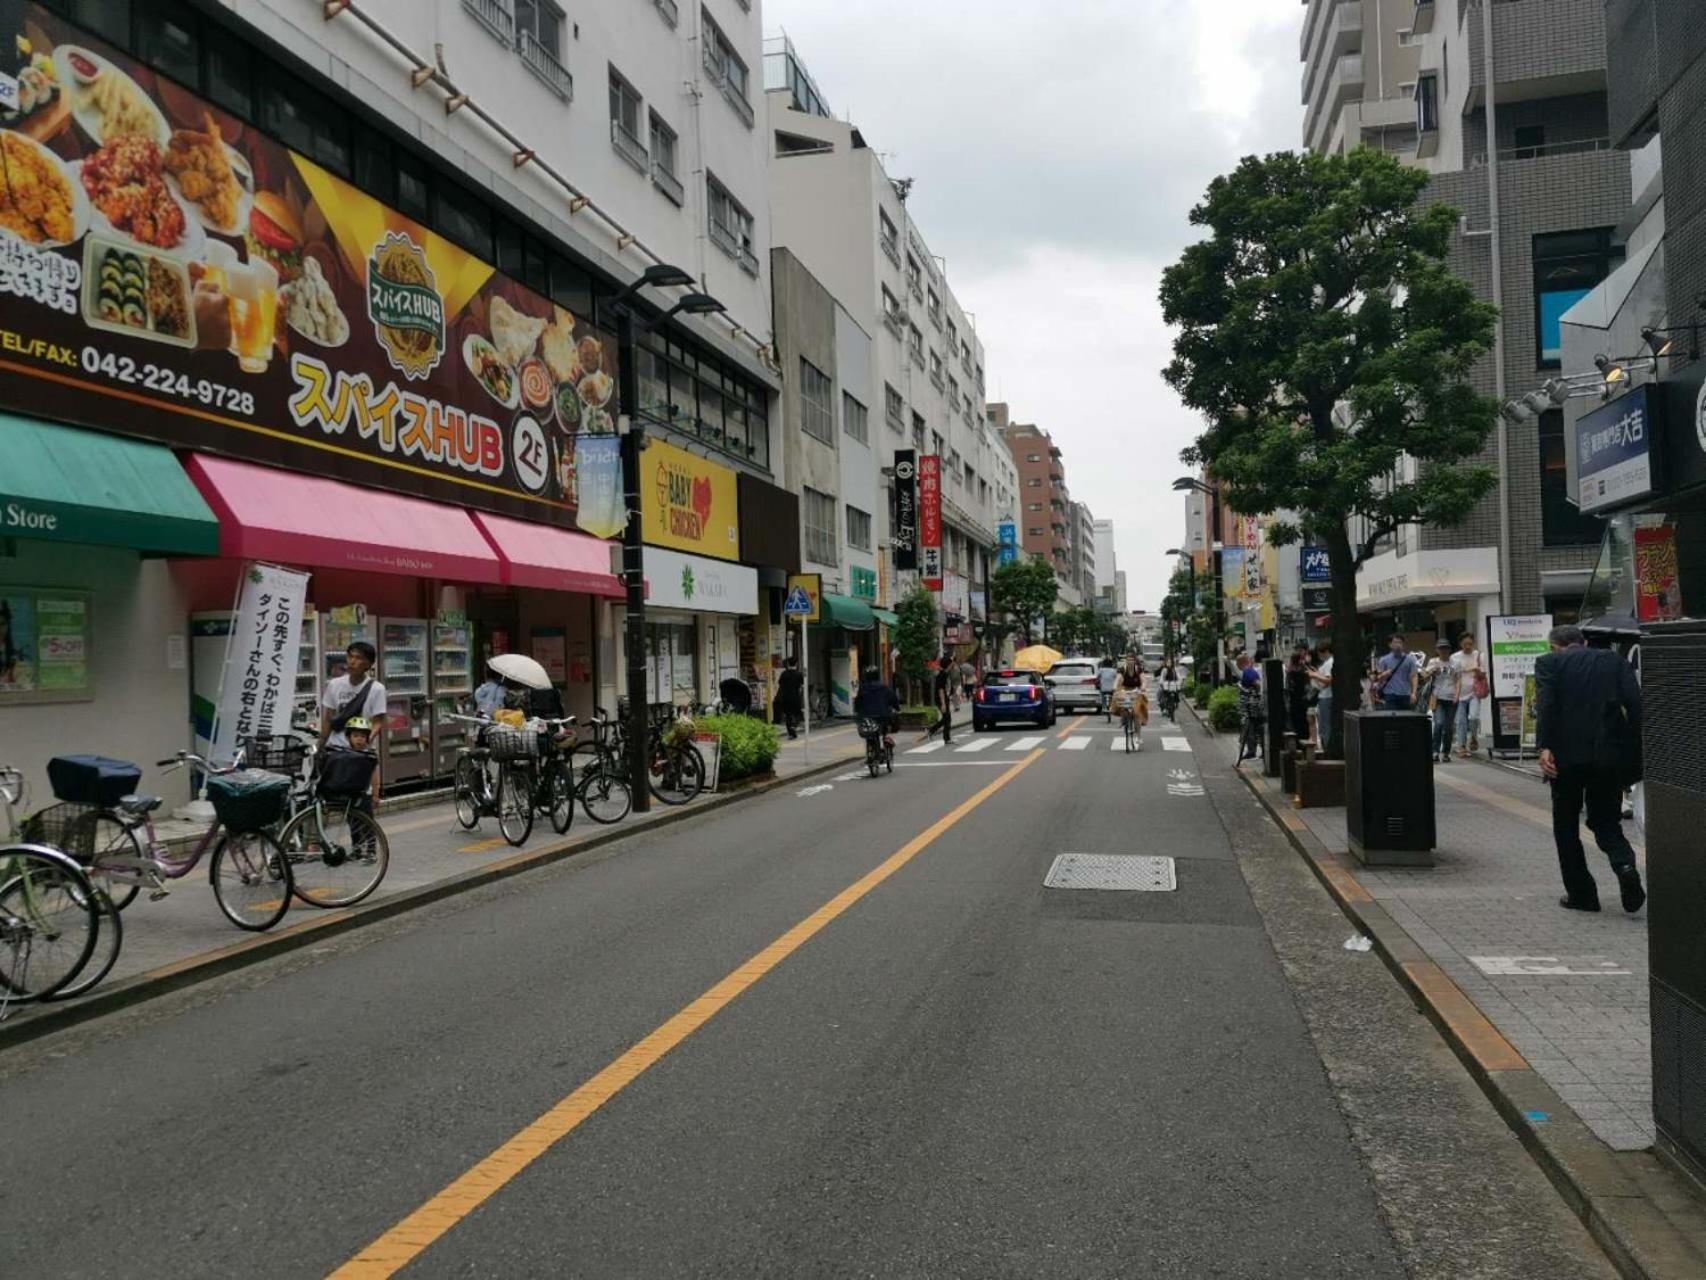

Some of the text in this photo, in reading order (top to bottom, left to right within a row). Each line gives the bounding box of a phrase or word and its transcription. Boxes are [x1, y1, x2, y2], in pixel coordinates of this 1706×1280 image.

[371, 281, 442, 324] スパイスHUB
[81, 346, 255, 416] 042-224-9728
[290, 355, 503, 474] スパイスHUB
[518, 428, 544, 470] 2F
[668, 470, 692, 510] BABY
[7, 503, 57, 530] Store
[670, 507, 701, 542] CHICKEN
